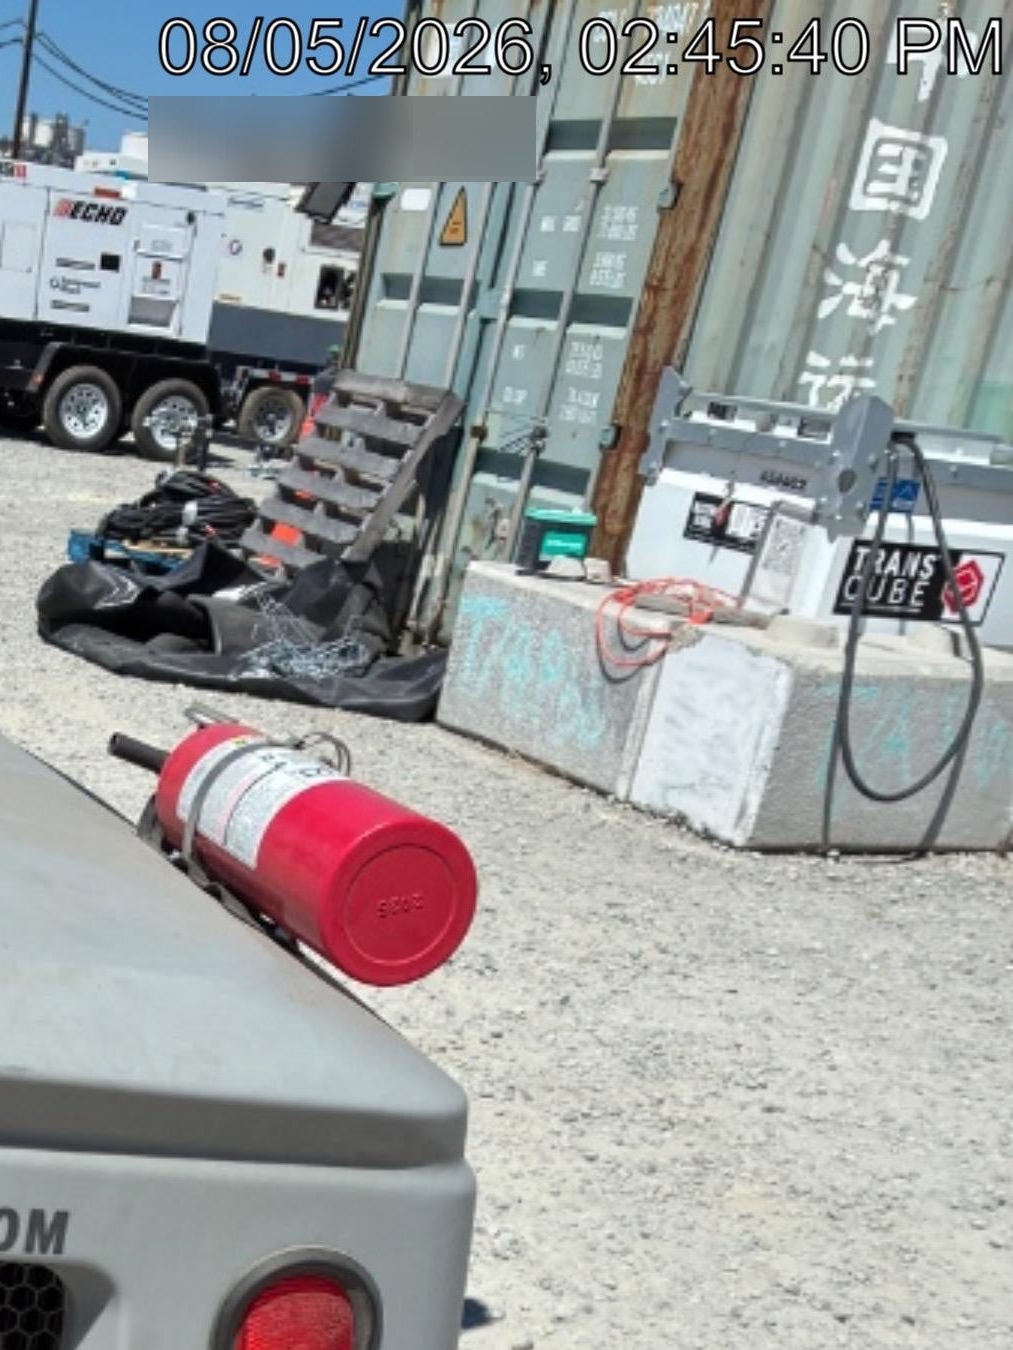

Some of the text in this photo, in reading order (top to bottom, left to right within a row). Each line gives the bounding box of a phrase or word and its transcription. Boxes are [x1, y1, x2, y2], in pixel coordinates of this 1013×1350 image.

[69, 201, 128, 226] ECHO
[855, 546, 938, 580] TRANS
[843, 575, 931, 607] CUBE
